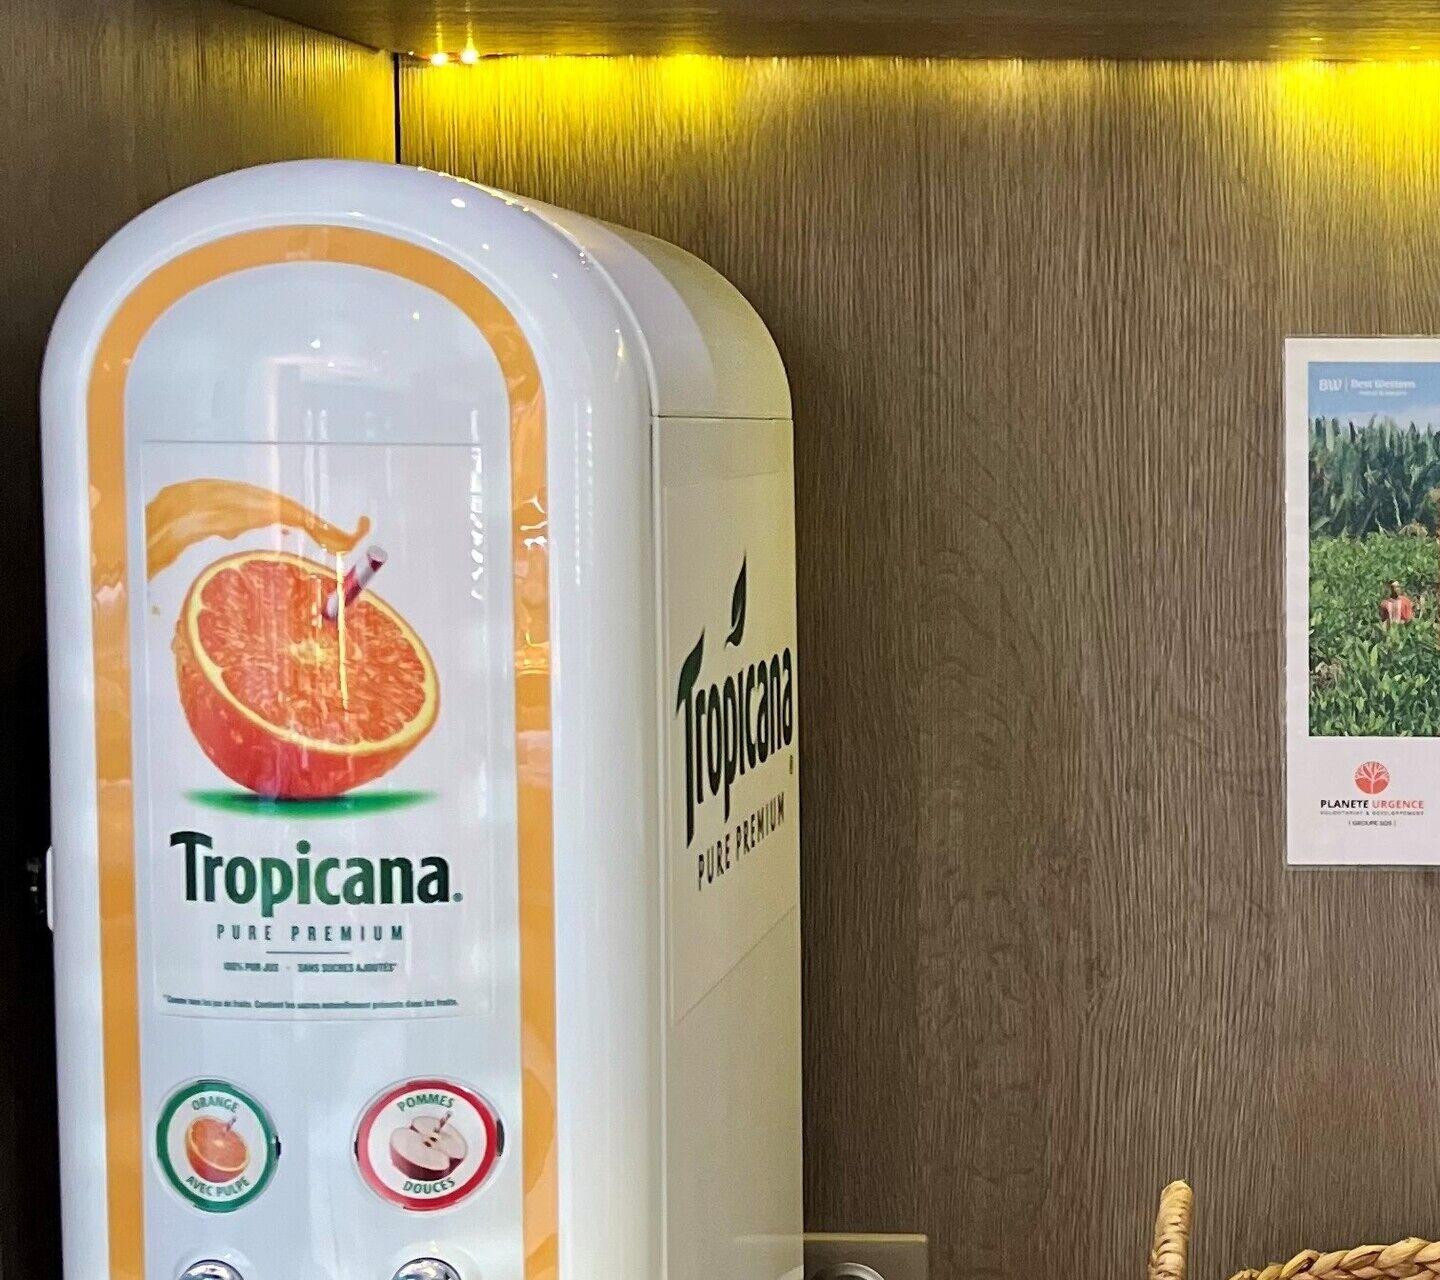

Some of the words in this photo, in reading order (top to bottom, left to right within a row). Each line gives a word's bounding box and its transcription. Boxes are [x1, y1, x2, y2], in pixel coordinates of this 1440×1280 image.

[676, 625, 794, 848] Tropicana
[1372, 800, 1424, 809] URGENCE
[698, 832, 731, 891] PURE
[735, 791, 785, 862] PREMIUM
[170, 831, 450, 917] Tropicana
[216, 923, 272, 941] PURE
[291, 925, 404, 942] PREMIUM
[191, 1095, 239, 1113] ORANGE
[396, 1093, 454, 1112] POMMES
[185, 1175, 213, 1197] AVEC
[216, 1176, 249, 1197] PULPE
[402, 1177, 456, 1195] DOUCES
